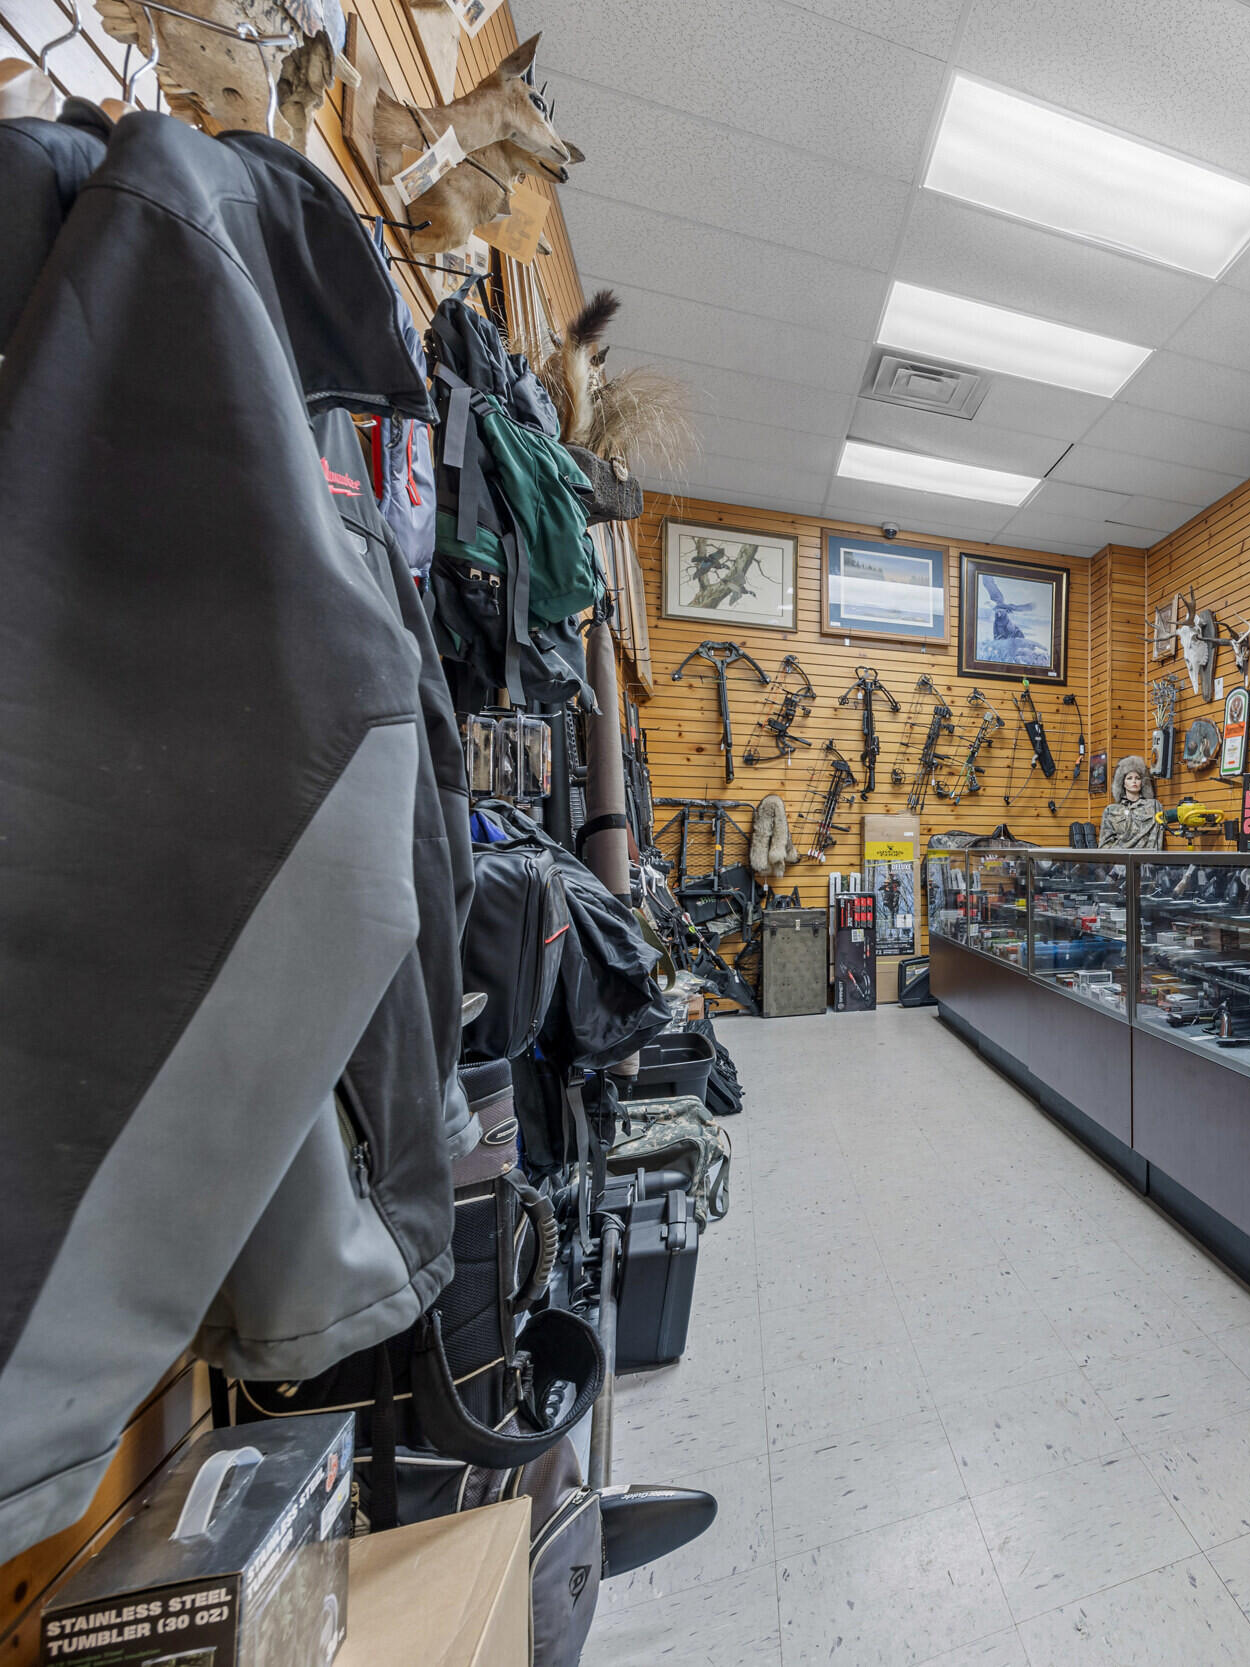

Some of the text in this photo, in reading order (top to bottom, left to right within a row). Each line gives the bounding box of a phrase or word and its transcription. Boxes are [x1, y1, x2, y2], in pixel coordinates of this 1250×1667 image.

[47, 1588, 232, 1636] STAINLESS STEEL
[47, 1606, 230, 1656] TUMBLER (30 OZ)
